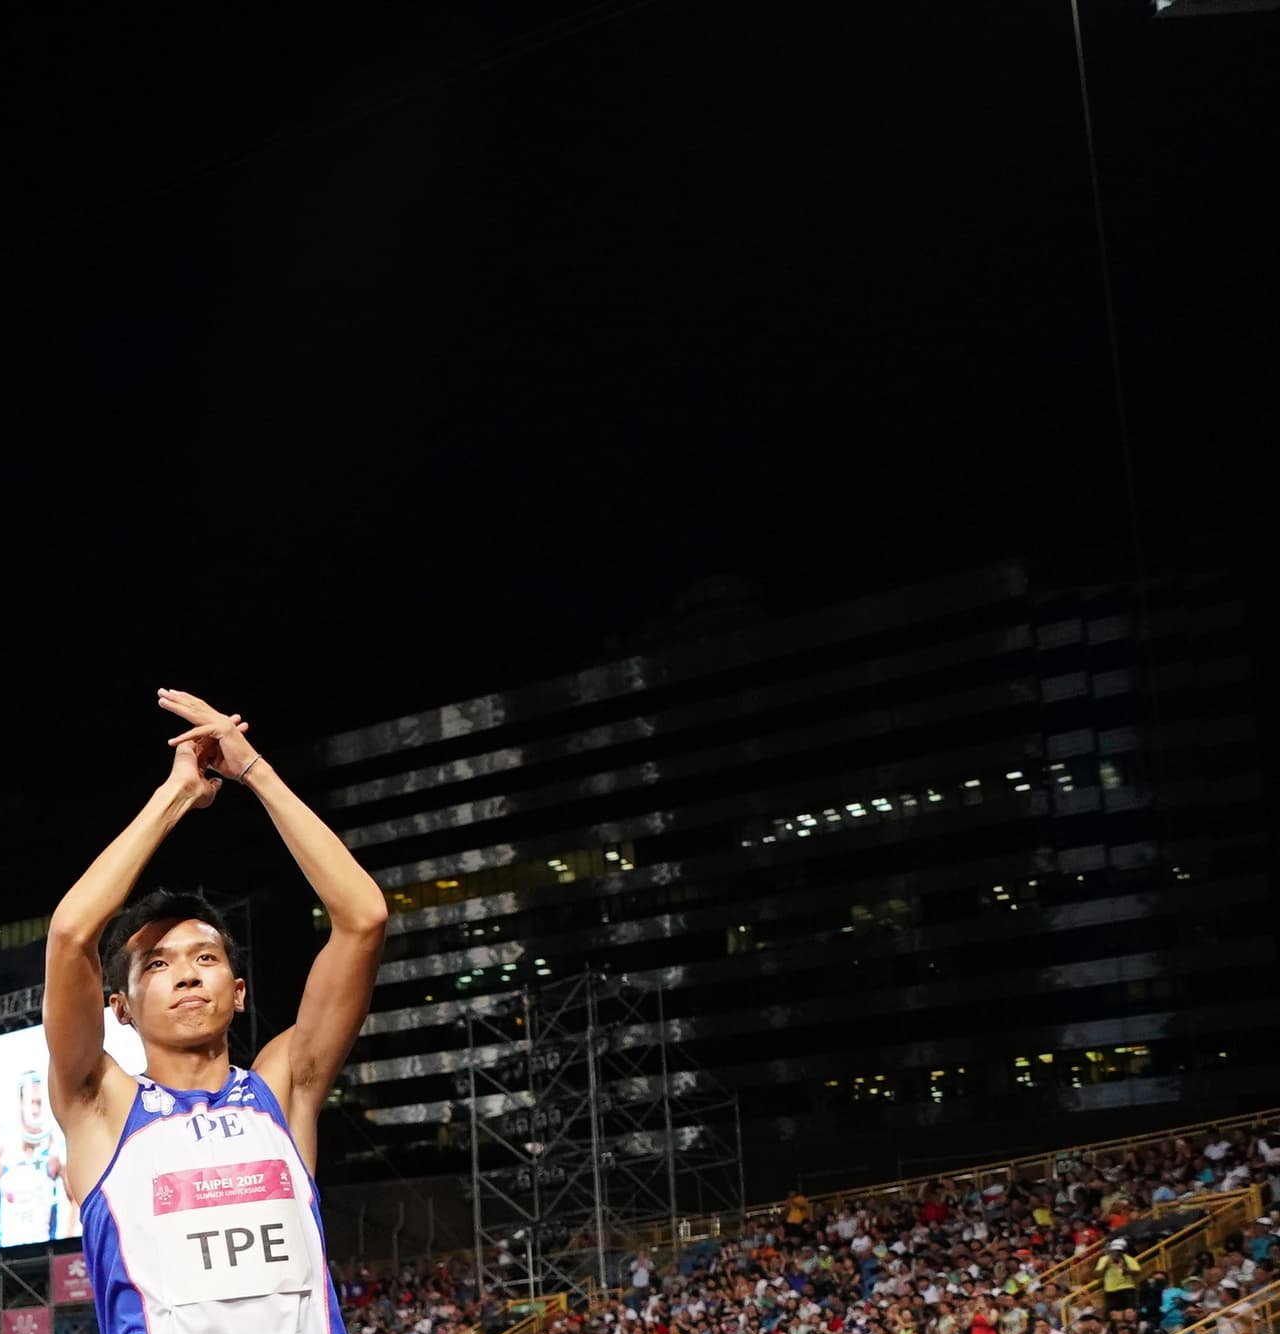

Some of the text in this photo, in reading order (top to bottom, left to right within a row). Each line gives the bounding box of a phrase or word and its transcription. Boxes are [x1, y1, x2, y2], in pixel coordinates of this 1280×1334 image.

[192, 1177, 234, 1193] TAIPEI
[237, 1173, 265, 1188] 2017
[186, 1223, 289, 1270] TPE
